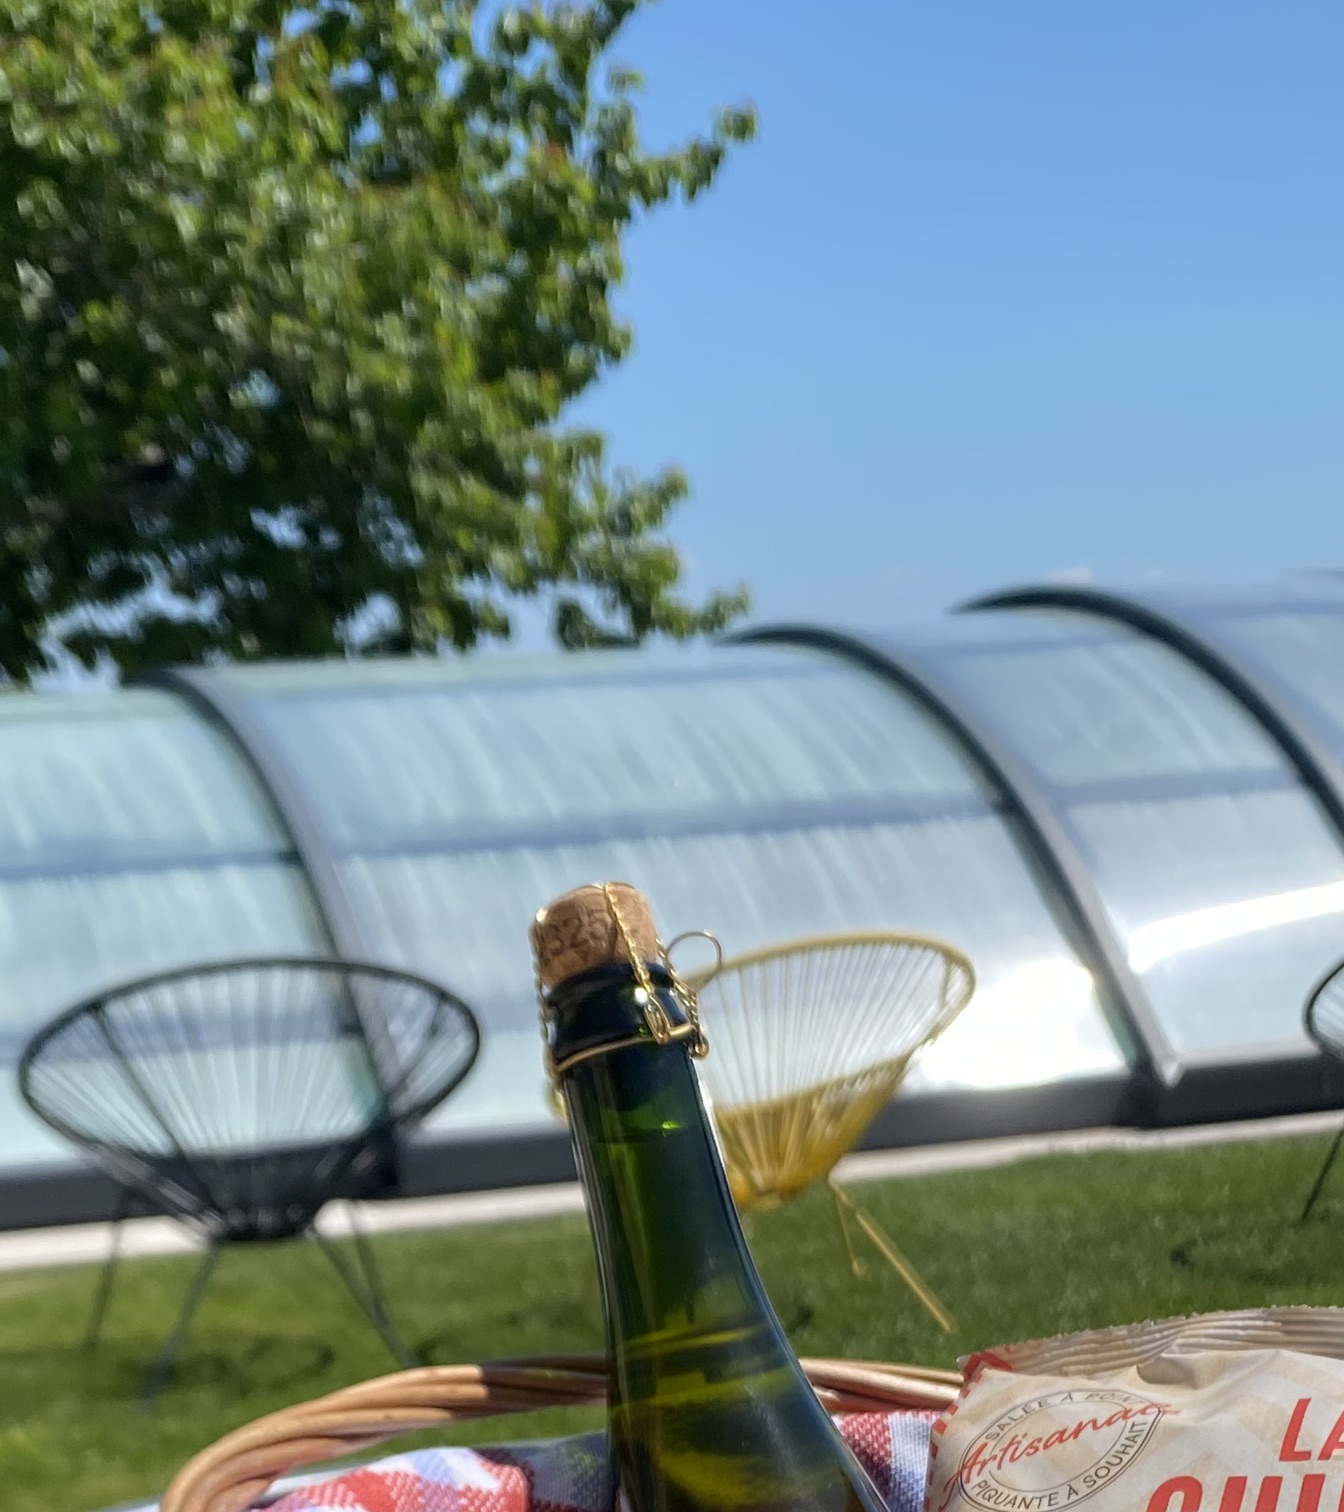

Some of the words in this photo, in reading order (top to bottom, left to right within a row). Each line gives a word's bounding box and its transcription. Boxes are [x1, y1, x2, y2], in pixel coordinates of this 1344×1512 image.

[970, 1479, 1059, 1510] PIQUANTE
[1066, 1484, 1079, 1501] À
[1082, 1420, 1149, 1489] SOUHAIT
